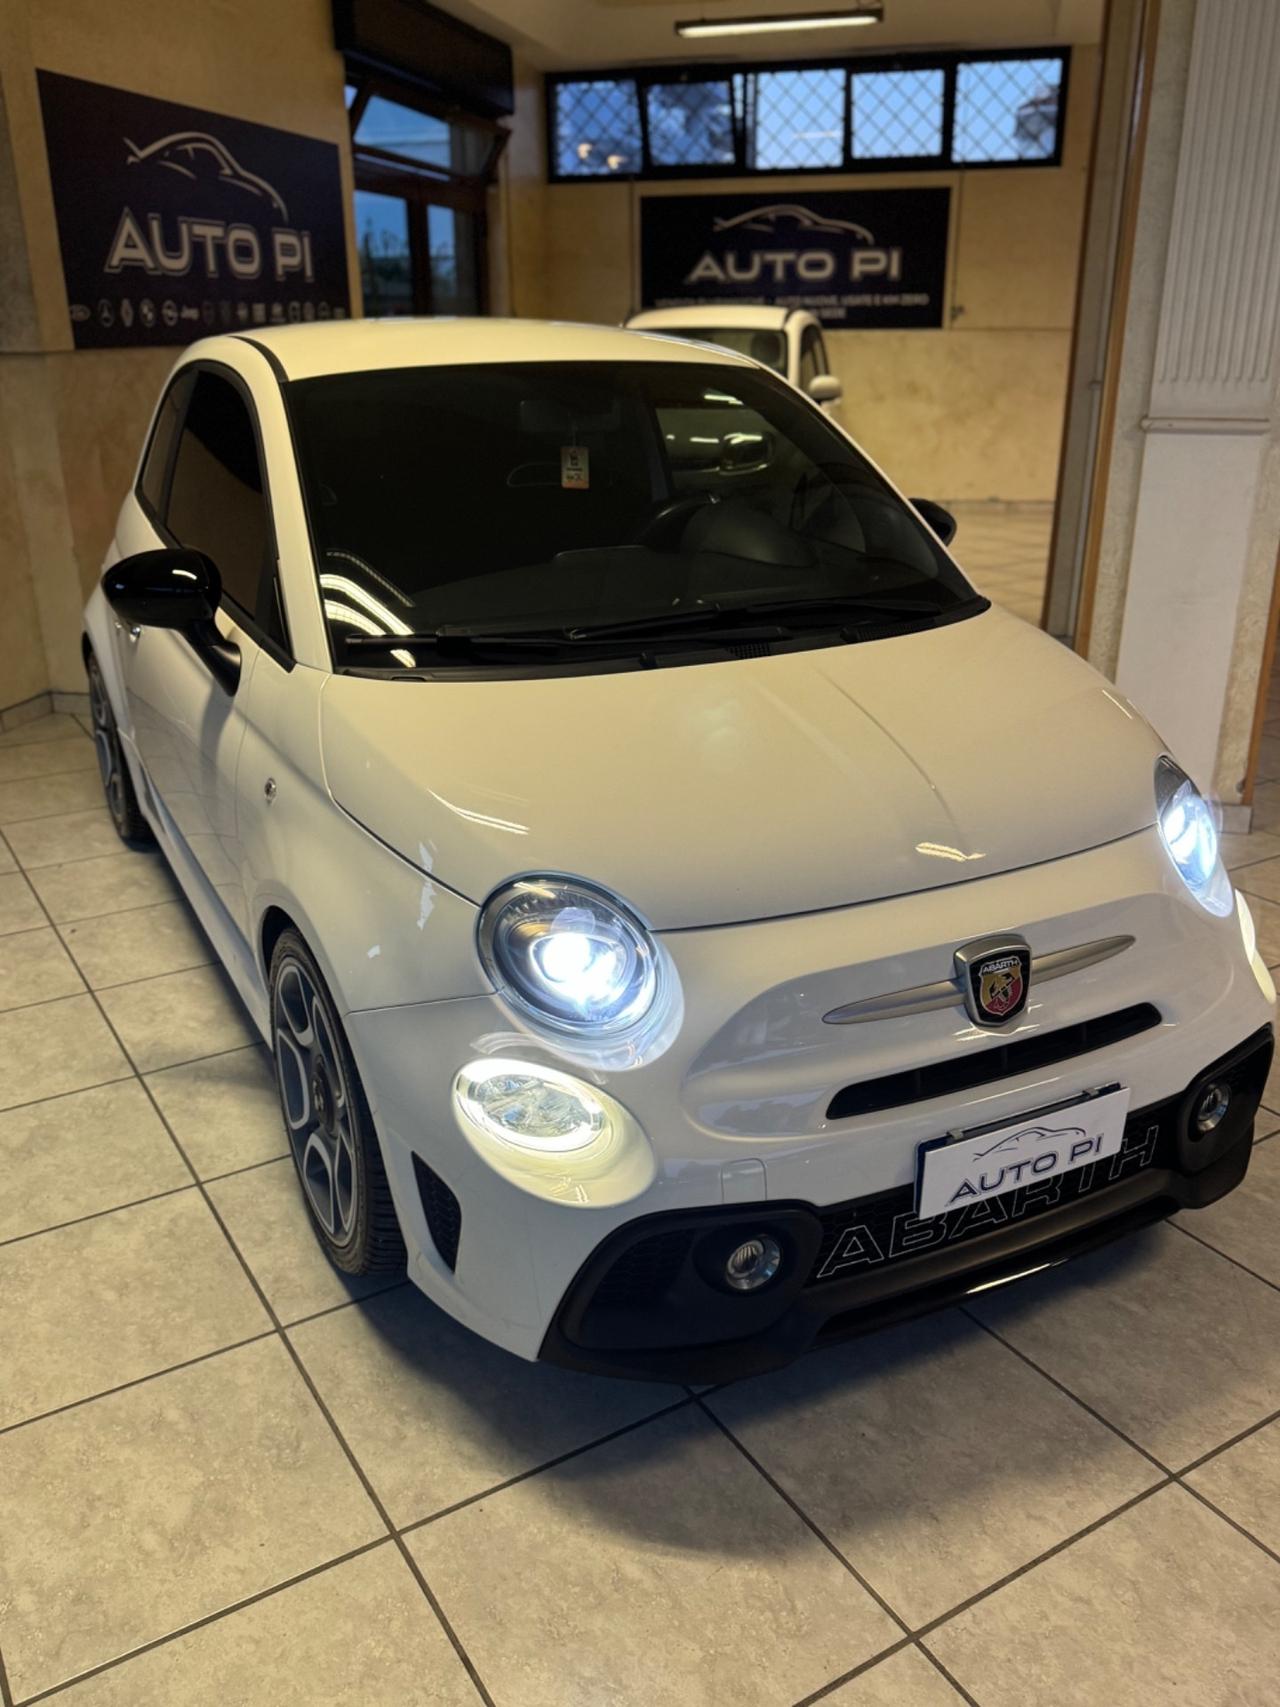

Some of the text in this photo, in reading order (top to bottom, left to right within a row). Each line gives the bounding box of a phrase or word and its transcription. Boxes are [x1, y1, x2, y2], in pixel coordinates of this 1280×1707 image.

[104, 205, 315, 282] AUTO PI
[687, 250, 902, 282] AUTO PI
[982, 959, 1019, 974] ABARTH
[944, 1133, 1105, 1207] AUTO PI
